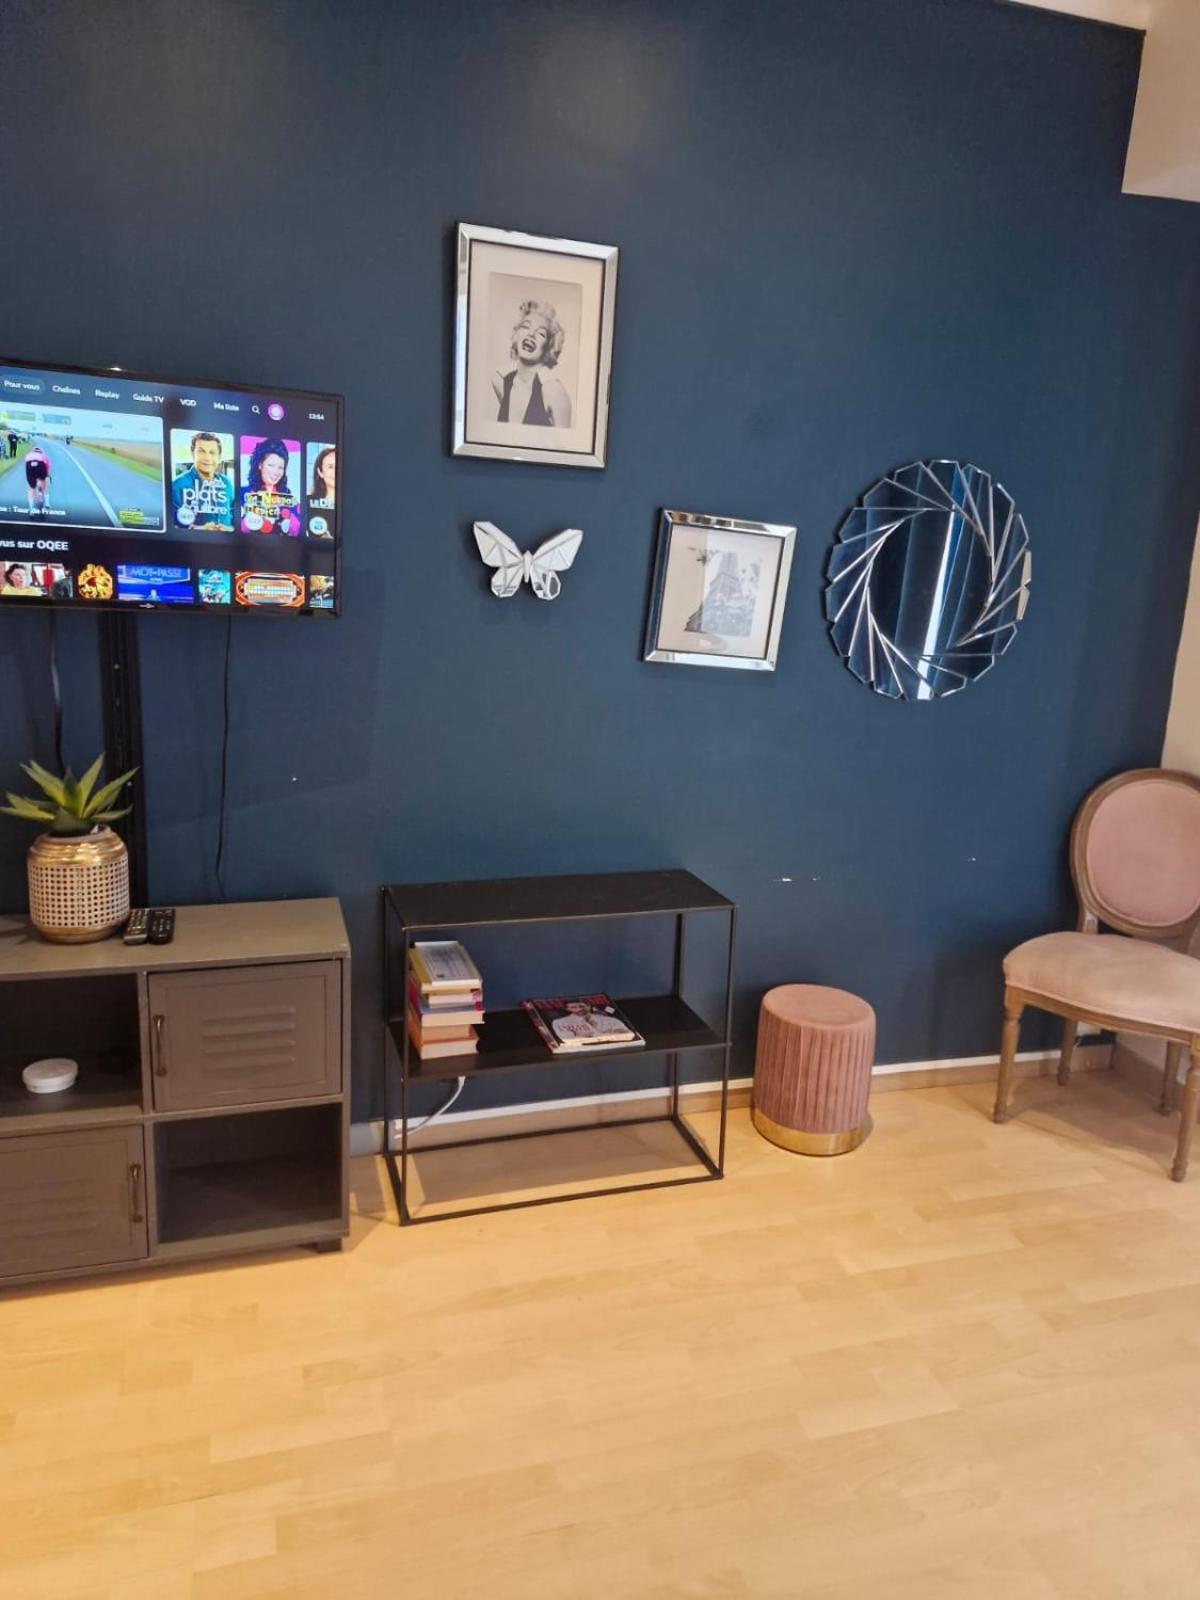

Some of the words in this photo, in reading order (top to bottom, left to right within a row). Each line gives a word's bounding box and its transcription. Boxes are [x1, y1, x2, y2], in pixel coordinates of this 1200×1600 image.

[3, 379, 22, 389] Pour
[95, 388, 120, 400] Replay
[132, 393, 153, 403] Guide
[179, 398, 197, 407] VOD
[182, 478, 227, 507] plats
[12, 505, 29, 513] Tour
[17, 541, 35, 550] sur
[36, 540, 69, 551] OQEE
